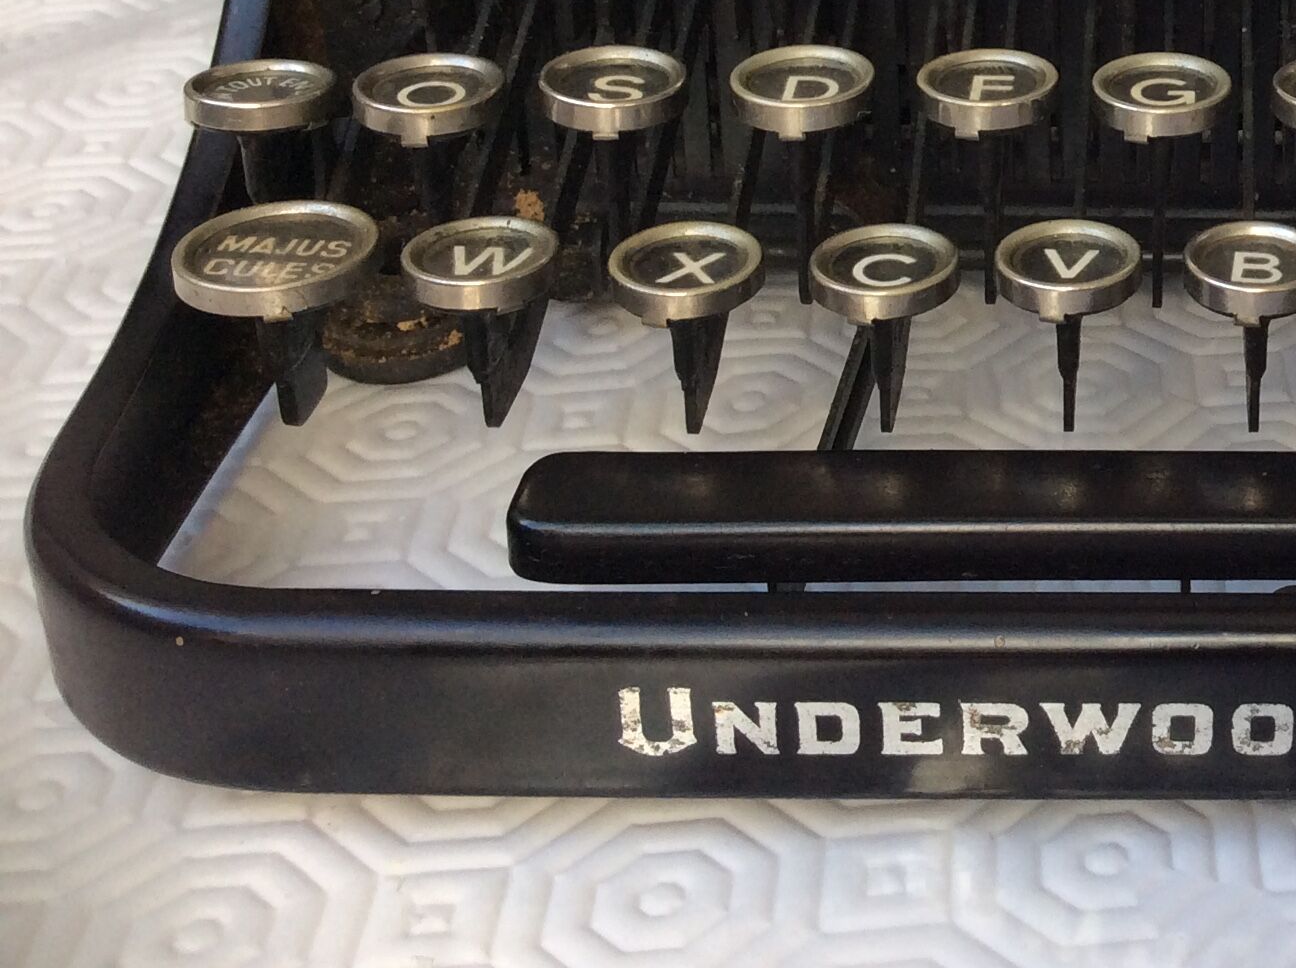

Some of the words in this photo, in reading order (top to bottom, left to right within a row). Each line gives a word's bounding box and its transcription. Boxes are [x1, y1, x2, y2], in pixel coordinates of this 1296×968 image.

[215, 76, 278, 93] TOUT
[587, 75, 644, 102] S
[781, 75, 838, 101] D
[968, 75, 1014, 101] F
[1130, 78, 1196, 105] G
[217, 235, 352, 258] MAJUS
[452, 244, 531, 276] W
[655, 252, 725, 285] X
[852, 253, 917, 287] C
[1044, 248, 1101, 279] V
[1231, 251, 1283, 283] B
